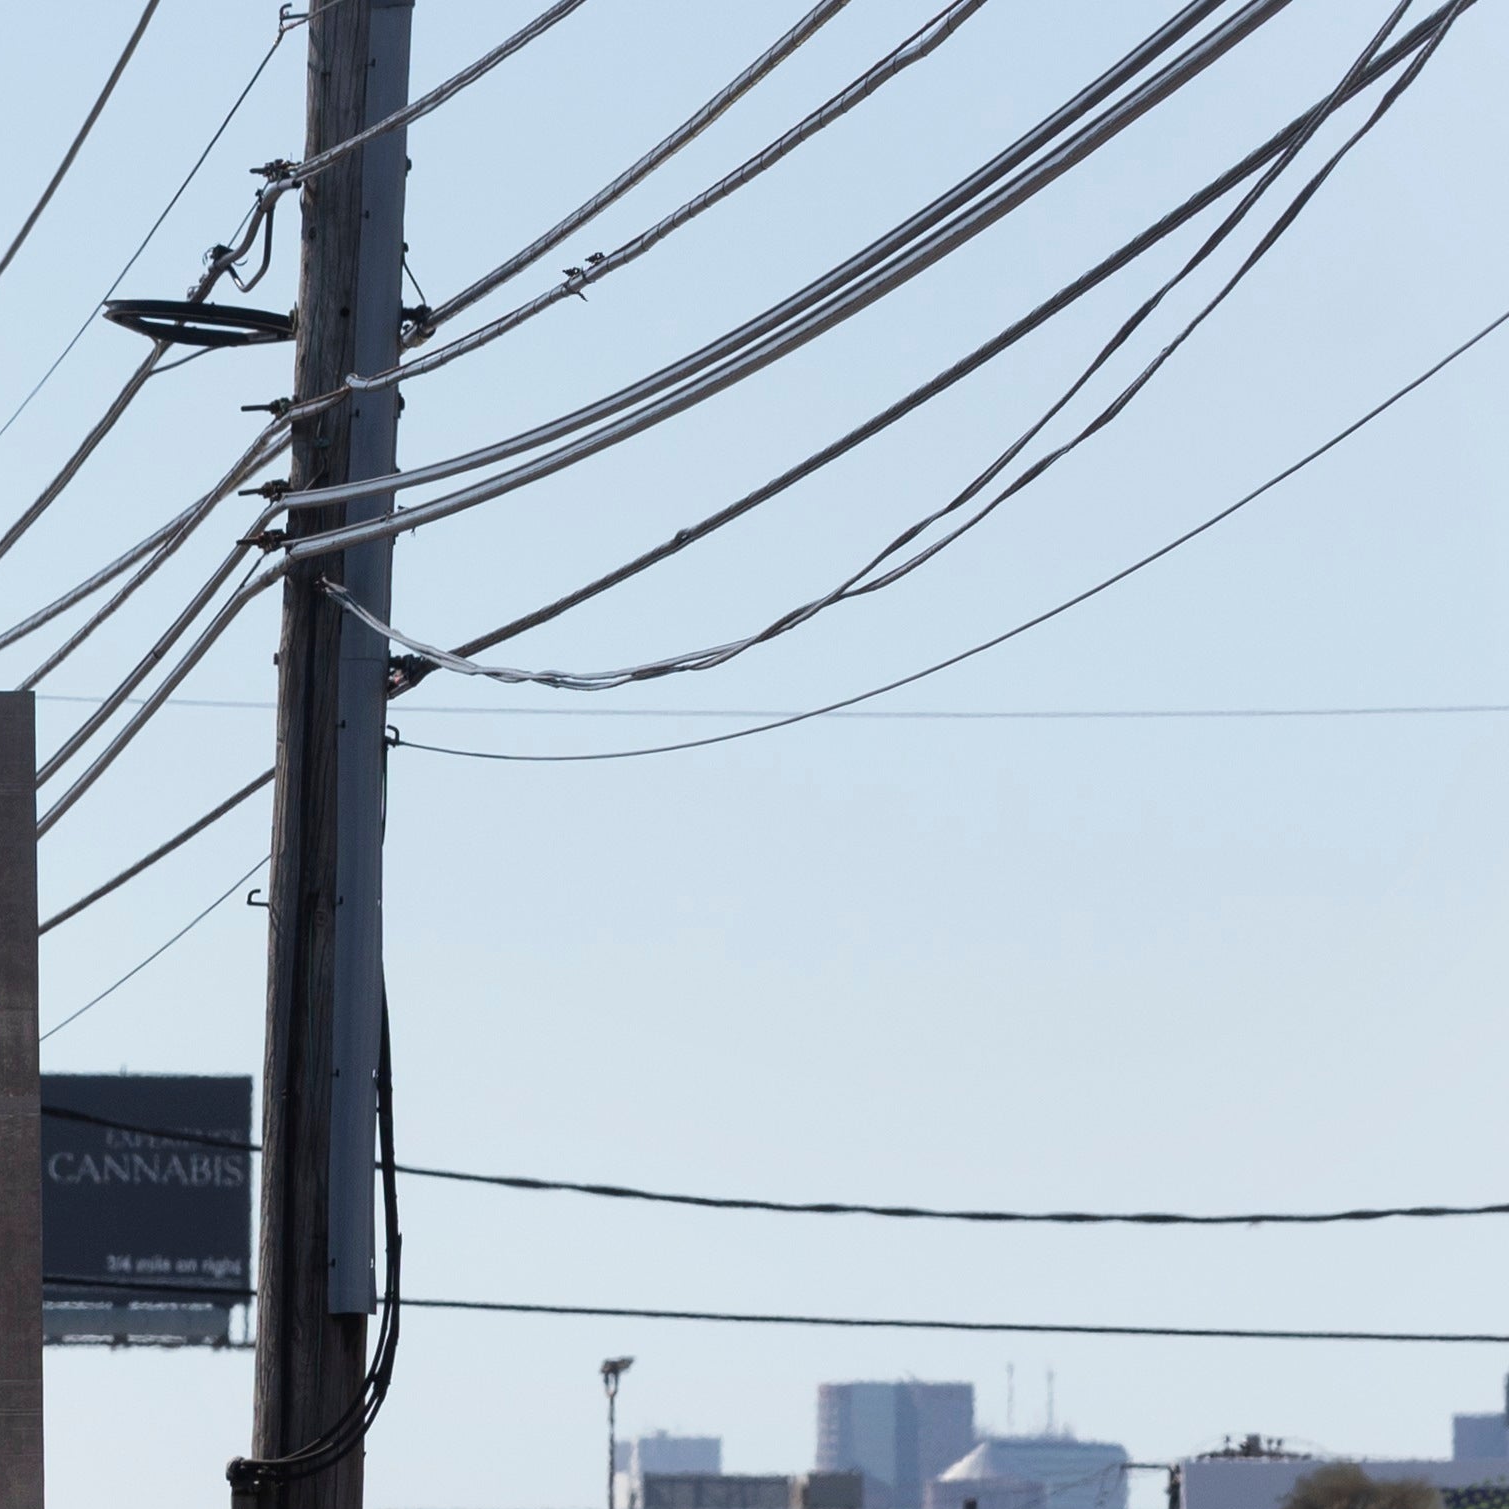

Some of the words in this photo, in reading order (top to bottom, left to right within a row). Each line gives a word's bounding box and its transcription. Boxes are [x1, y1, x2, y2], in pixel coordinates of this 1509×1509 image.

[47, 1152, 244, 1187] CANNABIS
[135, 1254, 171, 1272] mile
[175, 1257, 197, 1272] on
[202, 1255, 242, 1278] right
